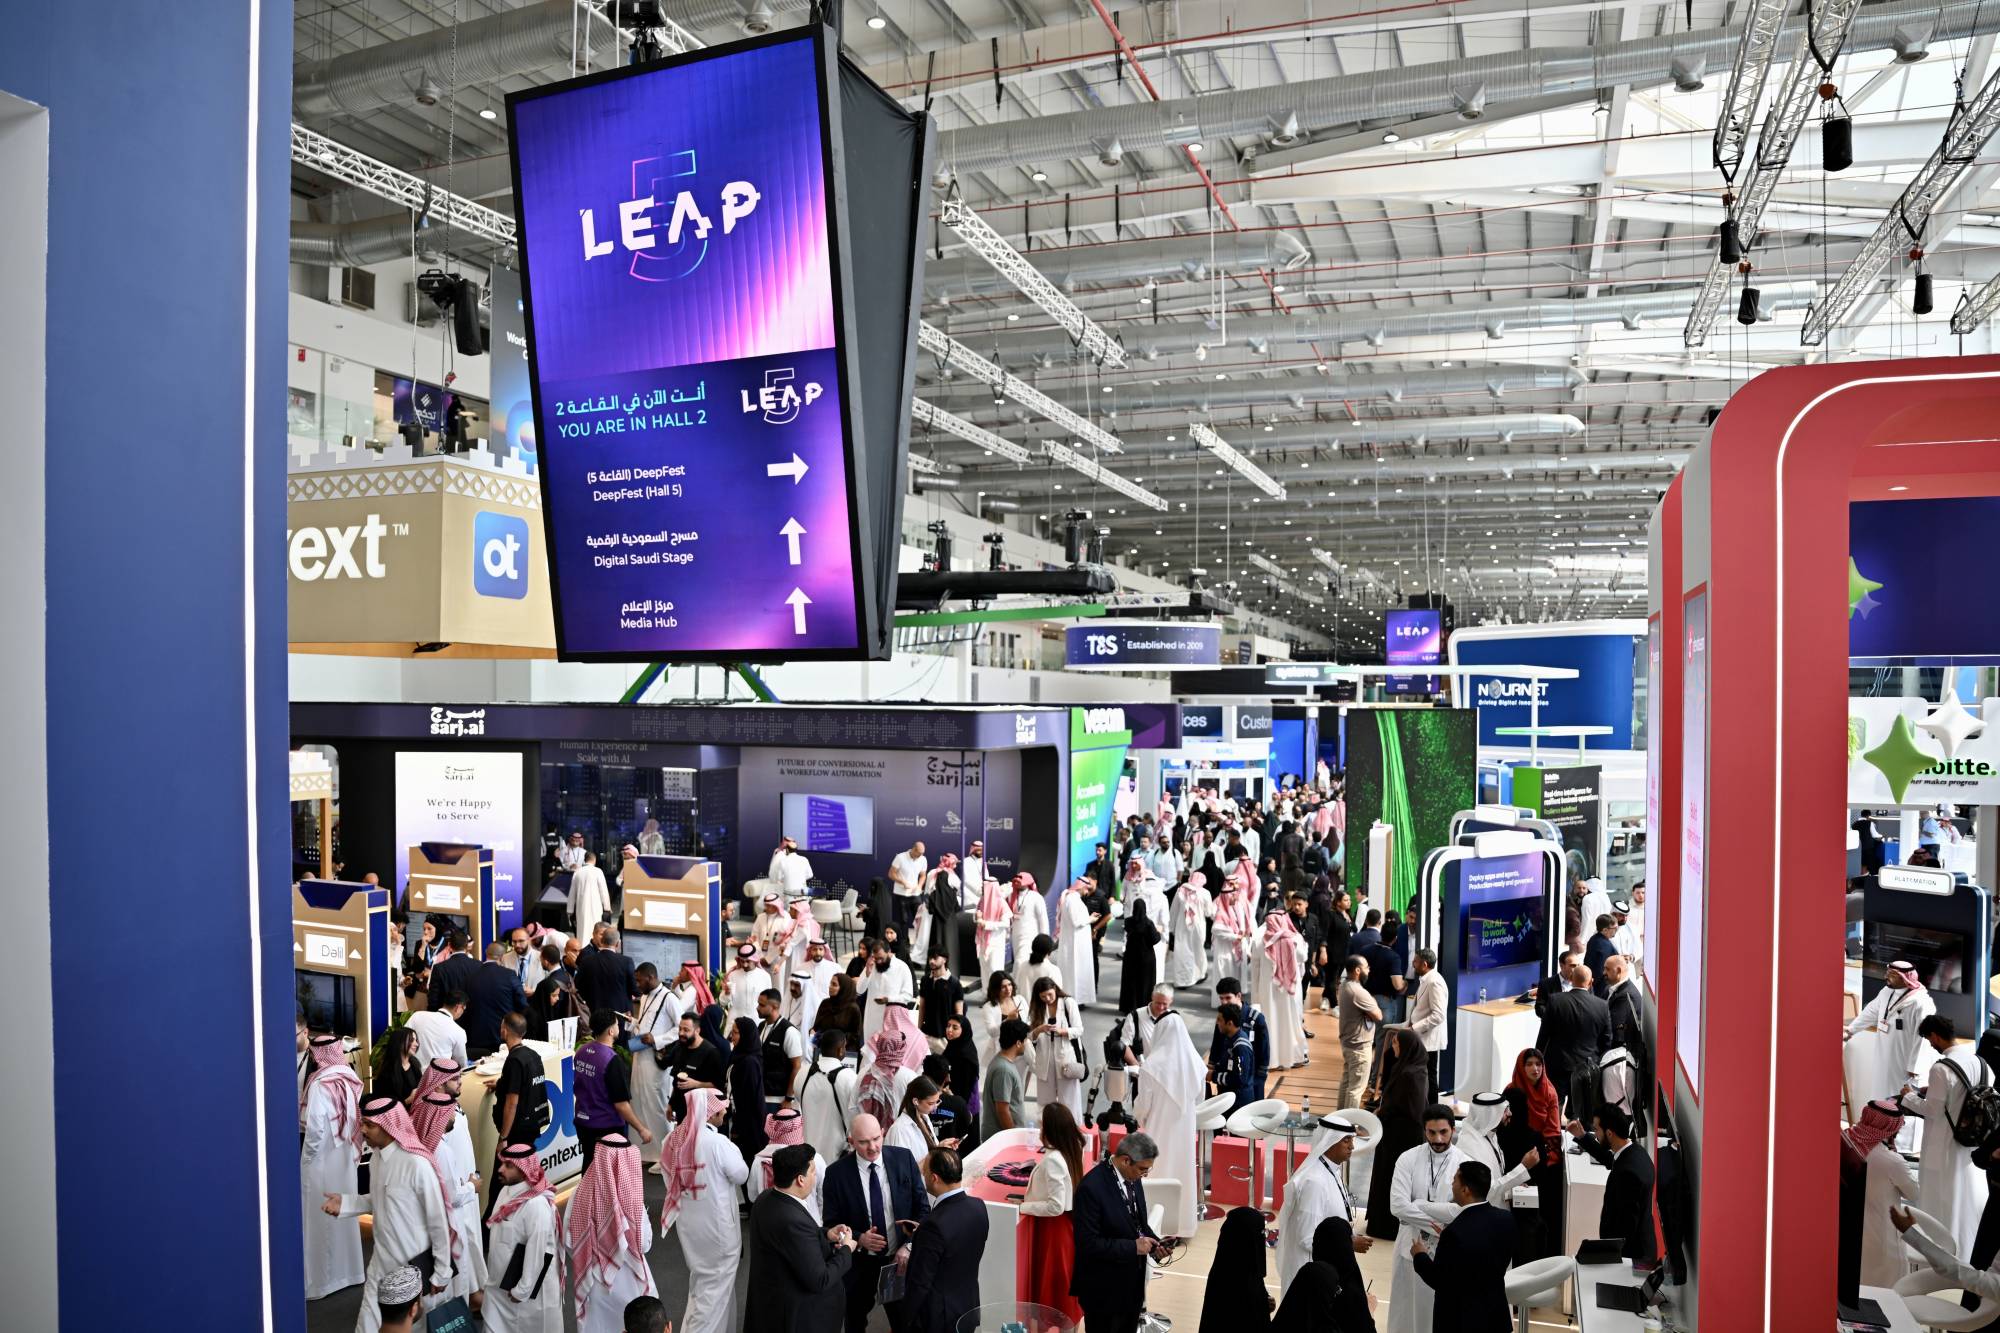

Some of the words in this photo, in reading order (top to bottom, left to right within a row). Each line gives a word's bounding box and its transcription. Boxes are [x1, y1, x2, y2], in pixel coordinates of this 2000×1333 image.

[580, 181, 761, 261] LEAP
[623, 395, 640, 415] في
[741, 382, 823, 413] LEAP
[556, 402, 565, 416] 2
[559, 424, 590, 438] YOU
[595, 419, 625, 435] ARE
[630, 416, 647, 431] IN
[652, 411, 693, 430] HALL
[697, 409, 707, 425] 2
[633, 464, 685, 481] DeepFest
[593, 488, 643, 503] DeepFest
[645, 485, 671, 500] (Hall
[671, 484, 683, 498] 5)
[586, 534, 620, 547] الرقمية
[621, 531, 668, 546] السعودية
[670, 530, 699, 546] مسرح
[287, 514, 387, 582] ext
[594, 554, 628, 568] Digital
[630, 553, 660, 565] Saudi
[662, 551, 694, 566] Stage
[621, 600, 652, 615] الإعلام
[654, 600, 674, 612] مركز
[620, 617, 653, 629] Media
[655, 616, 678, 629] Hub
[1396, 626, 1430, 636] LEAP
[1086, 635, 1119, 655] T&S
[1126, 641, 1178, 651] Established
[1178, 641, 1186, 650] in
[1186, 641, 1204, 650] 2009
[430, 706, 485, 723] سرج
[430, 719, 485, 737] sarj.ai
[806, 759, 817, 767] OF
[1918, 758, 1997, 776] oitte.
[786, 767, 830, 777] WORKFLOW
[831, 769, 883, 778] AUTOMATION
[1948, 779, 1979, 787] progress
[427, 798, 456, 807] We're
[460, 799, 492, 809] Happy
[437, 812, 447, 820] to
[450, 812, 479, 820] Serve
[1481, 937, 1491, 947] for
[1492, 935, 1514, 947] people
[539, 1143, 583, 1172] entext
